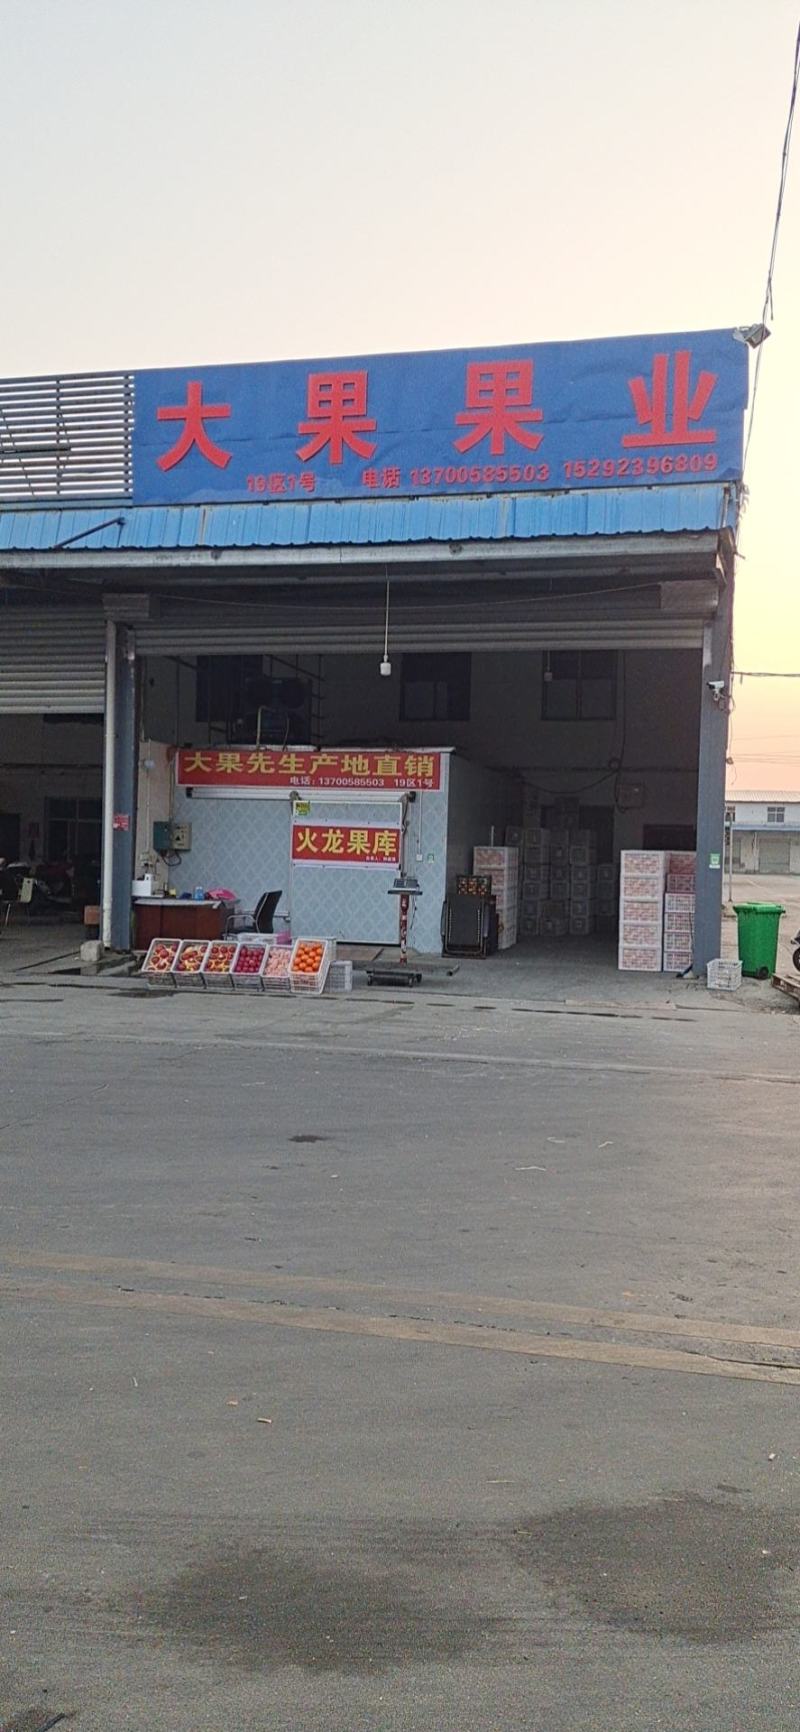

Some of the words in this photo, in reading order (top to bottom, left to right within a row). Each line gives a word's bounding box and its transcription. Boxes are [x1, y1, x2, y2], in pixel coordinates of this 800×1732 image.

[156, 351, 719, 471] 大果果业
[362, 467, 401, 488] 电话
[410, 463, 549, 486] 13700585503
[563, 453, 719, 479] 15292396809
[184, 752, 434, 777] 大果先生产地直销
[394, 778, 433, 788] 19区1号
[296, 828, 397, 856] 火龙果库
